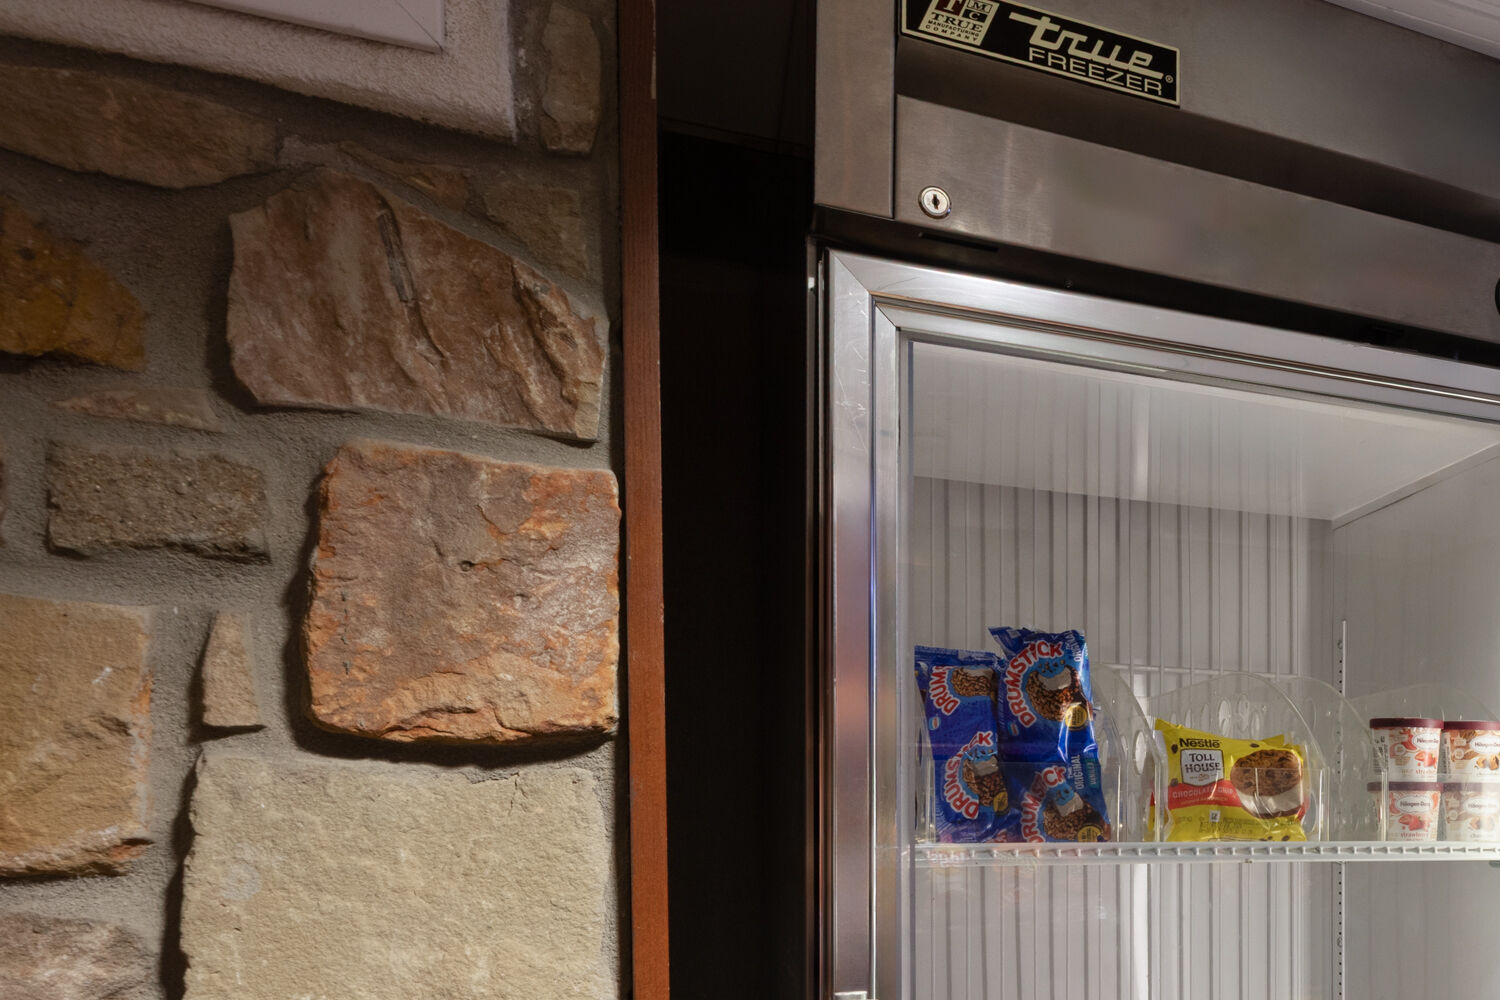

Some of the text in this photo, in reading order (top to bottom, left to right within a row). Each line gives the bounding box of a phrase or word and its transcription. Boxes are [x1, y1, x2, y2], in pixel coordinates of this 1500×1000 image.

[931, 12, 983, 33] TRUE
[968, 11, 981, 20] C
[928, 20, 980, 37] MANUFACTURING
[1028, 47, 1163, 96] FREEZER
[1004, 640, 1065, 728] DRUMSTICK
[1188, 752, 1216, 763] TOLL
[1184, 761, 1222, 774] HOUSE
